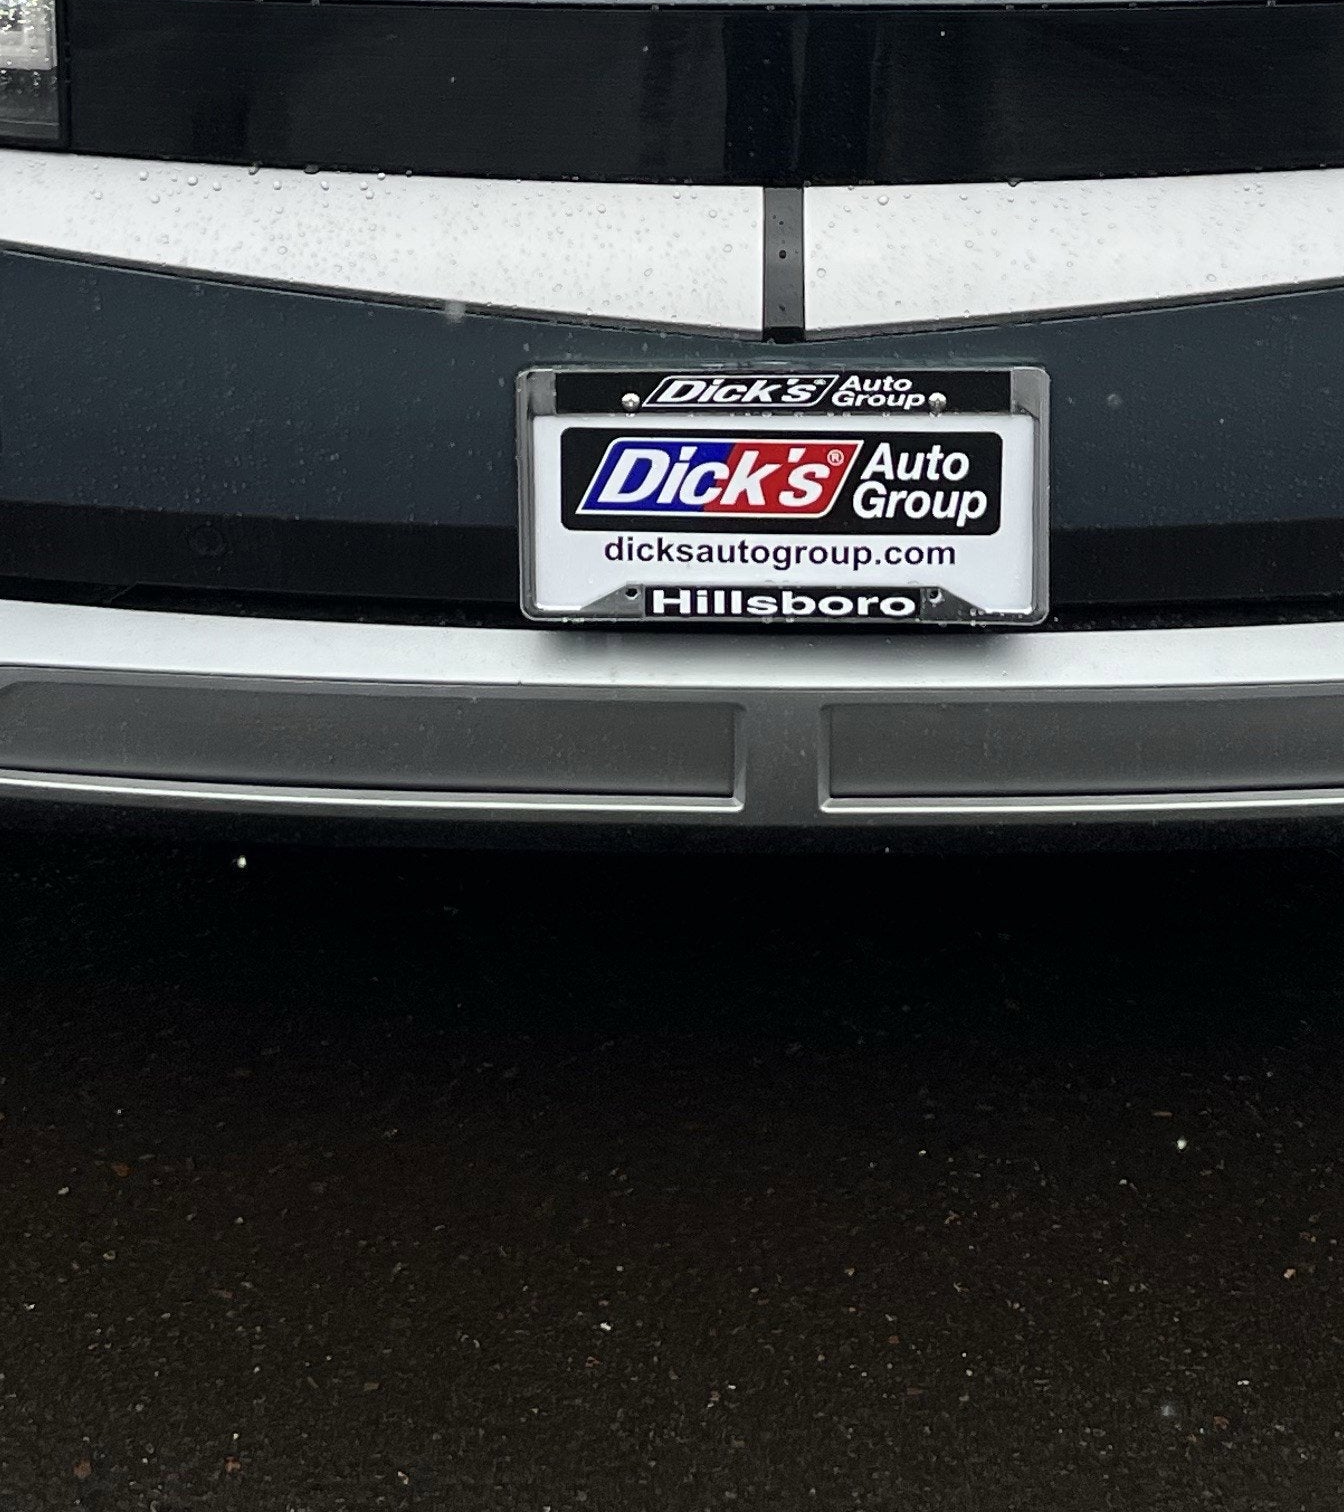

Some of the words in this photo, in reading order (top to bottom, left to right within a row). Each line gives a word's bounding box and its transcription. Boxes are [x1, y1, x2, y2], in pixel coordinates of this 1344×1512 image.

[839, 375, 913, 392] Auto
[831, 389, 925, 410] Group
[860, 442, 970, 481] Auto
[852, 480, 988, 527] Group
[604, 536, 956, 571] dicksautogroup.com
[652, 589, 916, 617] Hillsboro
